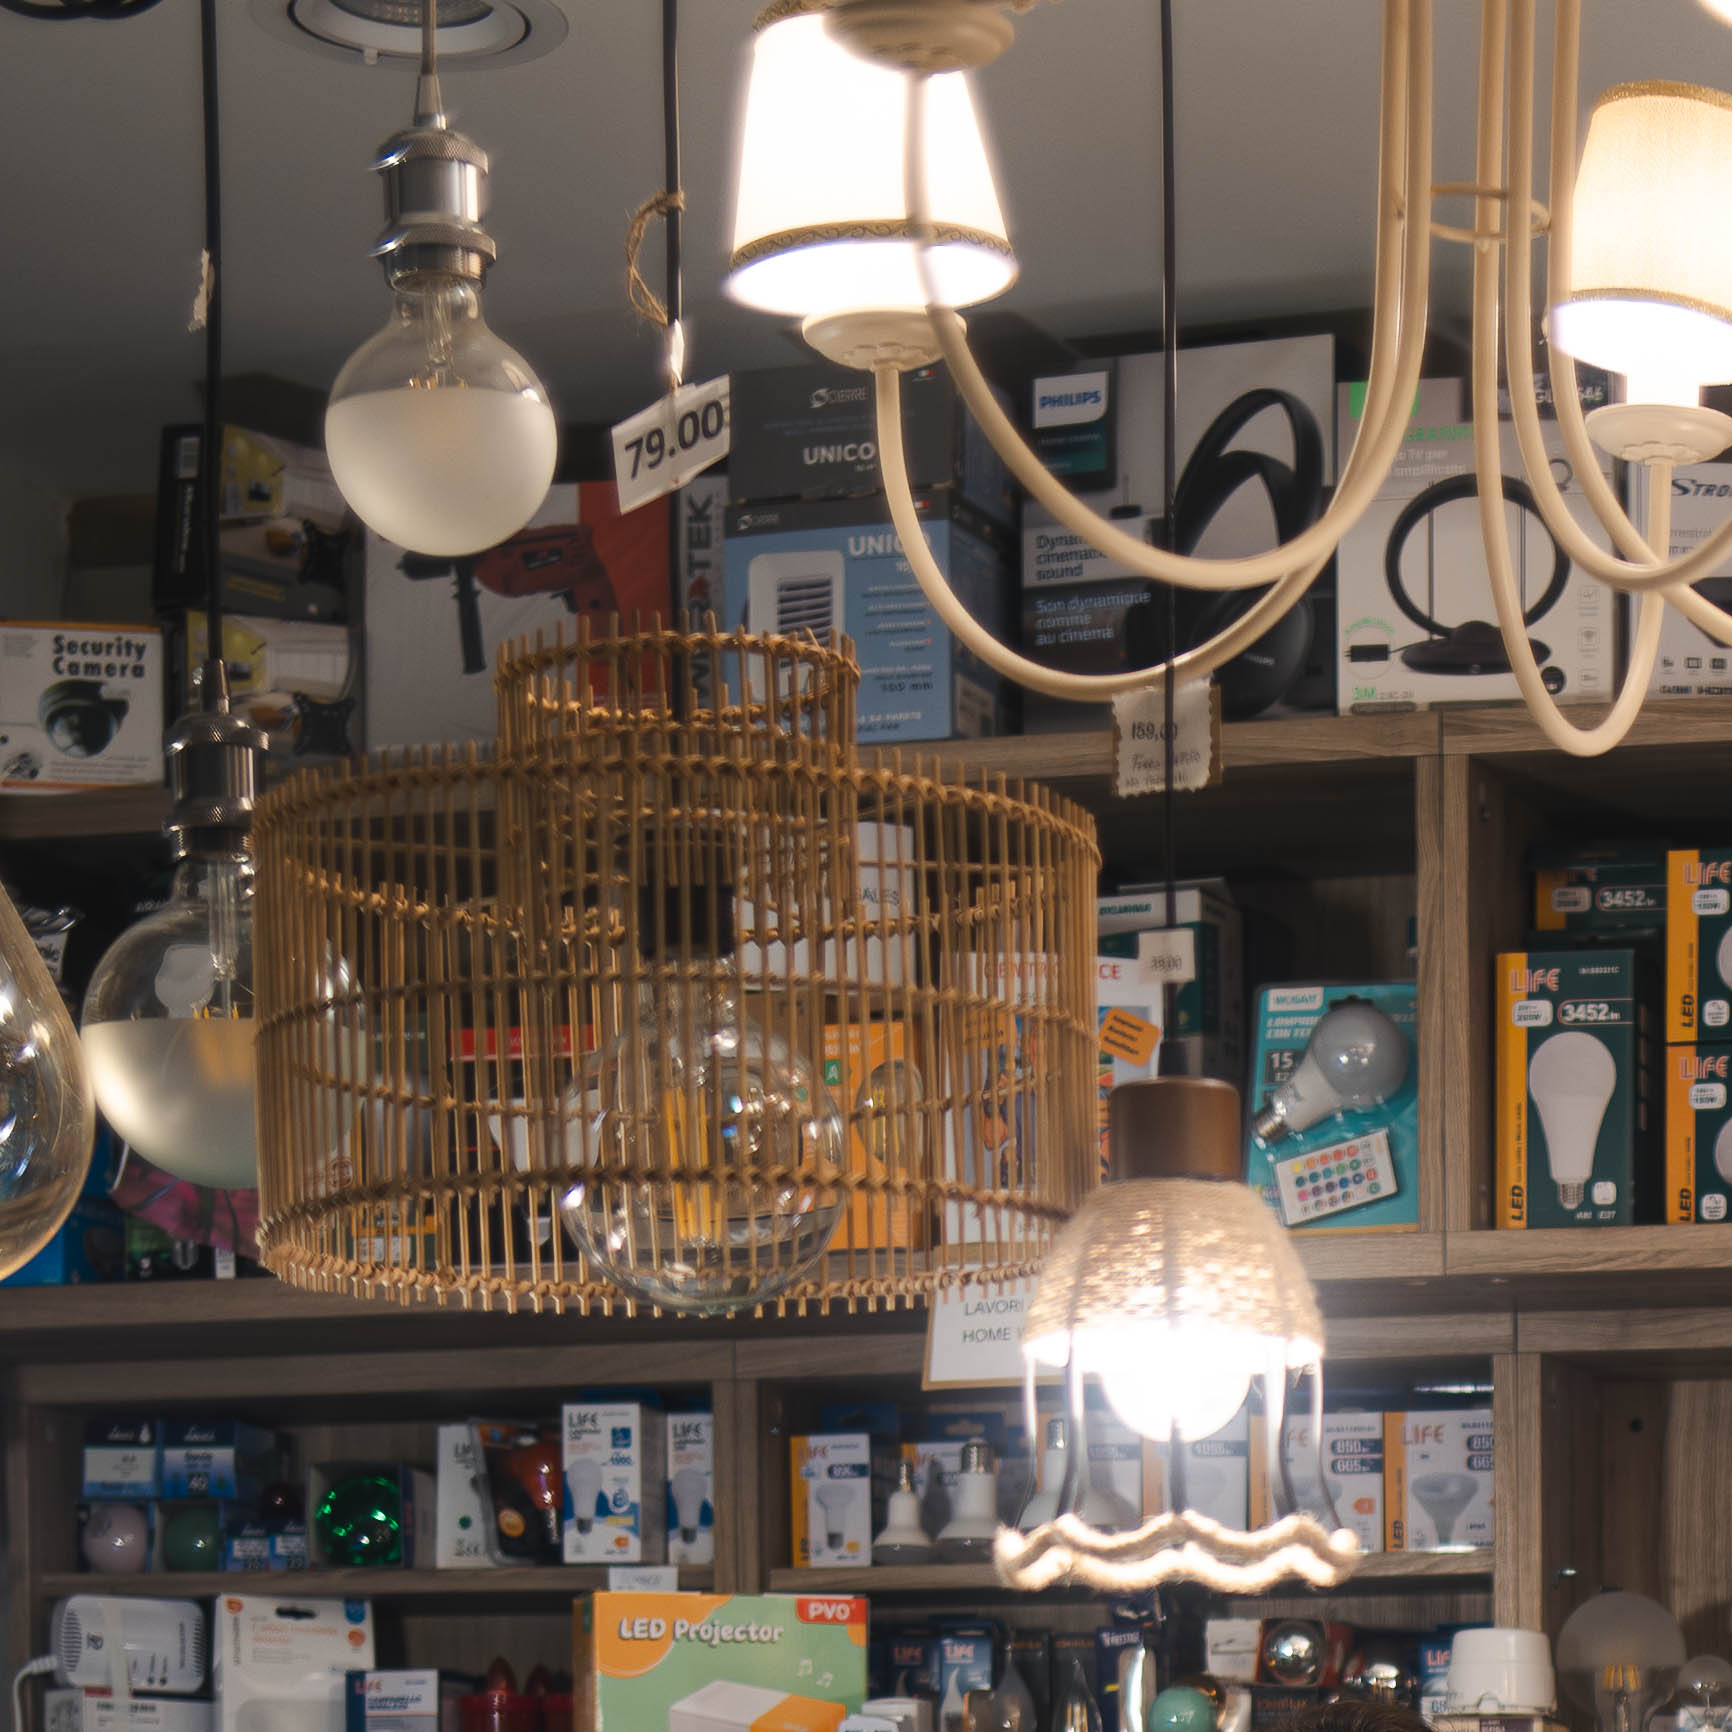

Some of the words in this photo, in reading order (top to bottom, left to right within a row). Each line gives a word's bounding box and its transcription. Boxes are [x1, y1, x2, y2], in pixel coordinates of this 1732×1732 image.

[1039, 391, 1100, 409] PHILIPS
[625, 400, 724, 480] 79.00
[804, 442, 876, 466] UNICO
[53, 635, 148, 662] Security
[53, 657, 146, 680] Camera
[1683, 862, 1732, 885] LIFE
[1602, 889, 1644, 908] 3452
[1511, 968, 1561, 992] LIFE
[1563, 1003, 1608, 1021] 3452
[1682, 994, 1693, 1028] LED
[1680, 1056, 1730, 1080] LIFE
[1511, 1185, 1524, 1221] LED
[1679, 1187, 1691, 1221] LED
[962, 1327, 1012, 1344] HOME
[568, 1413, 599, 1428] LIFE
[672, 1422, 703, 1439] LIFE
[1401, 1424, 1445, 1445] LIFE
[809, 1602, 851, 1620] PVO
[619, 1618, 666, 1640] LED
[674, 1618, 785, 1646] Projector
